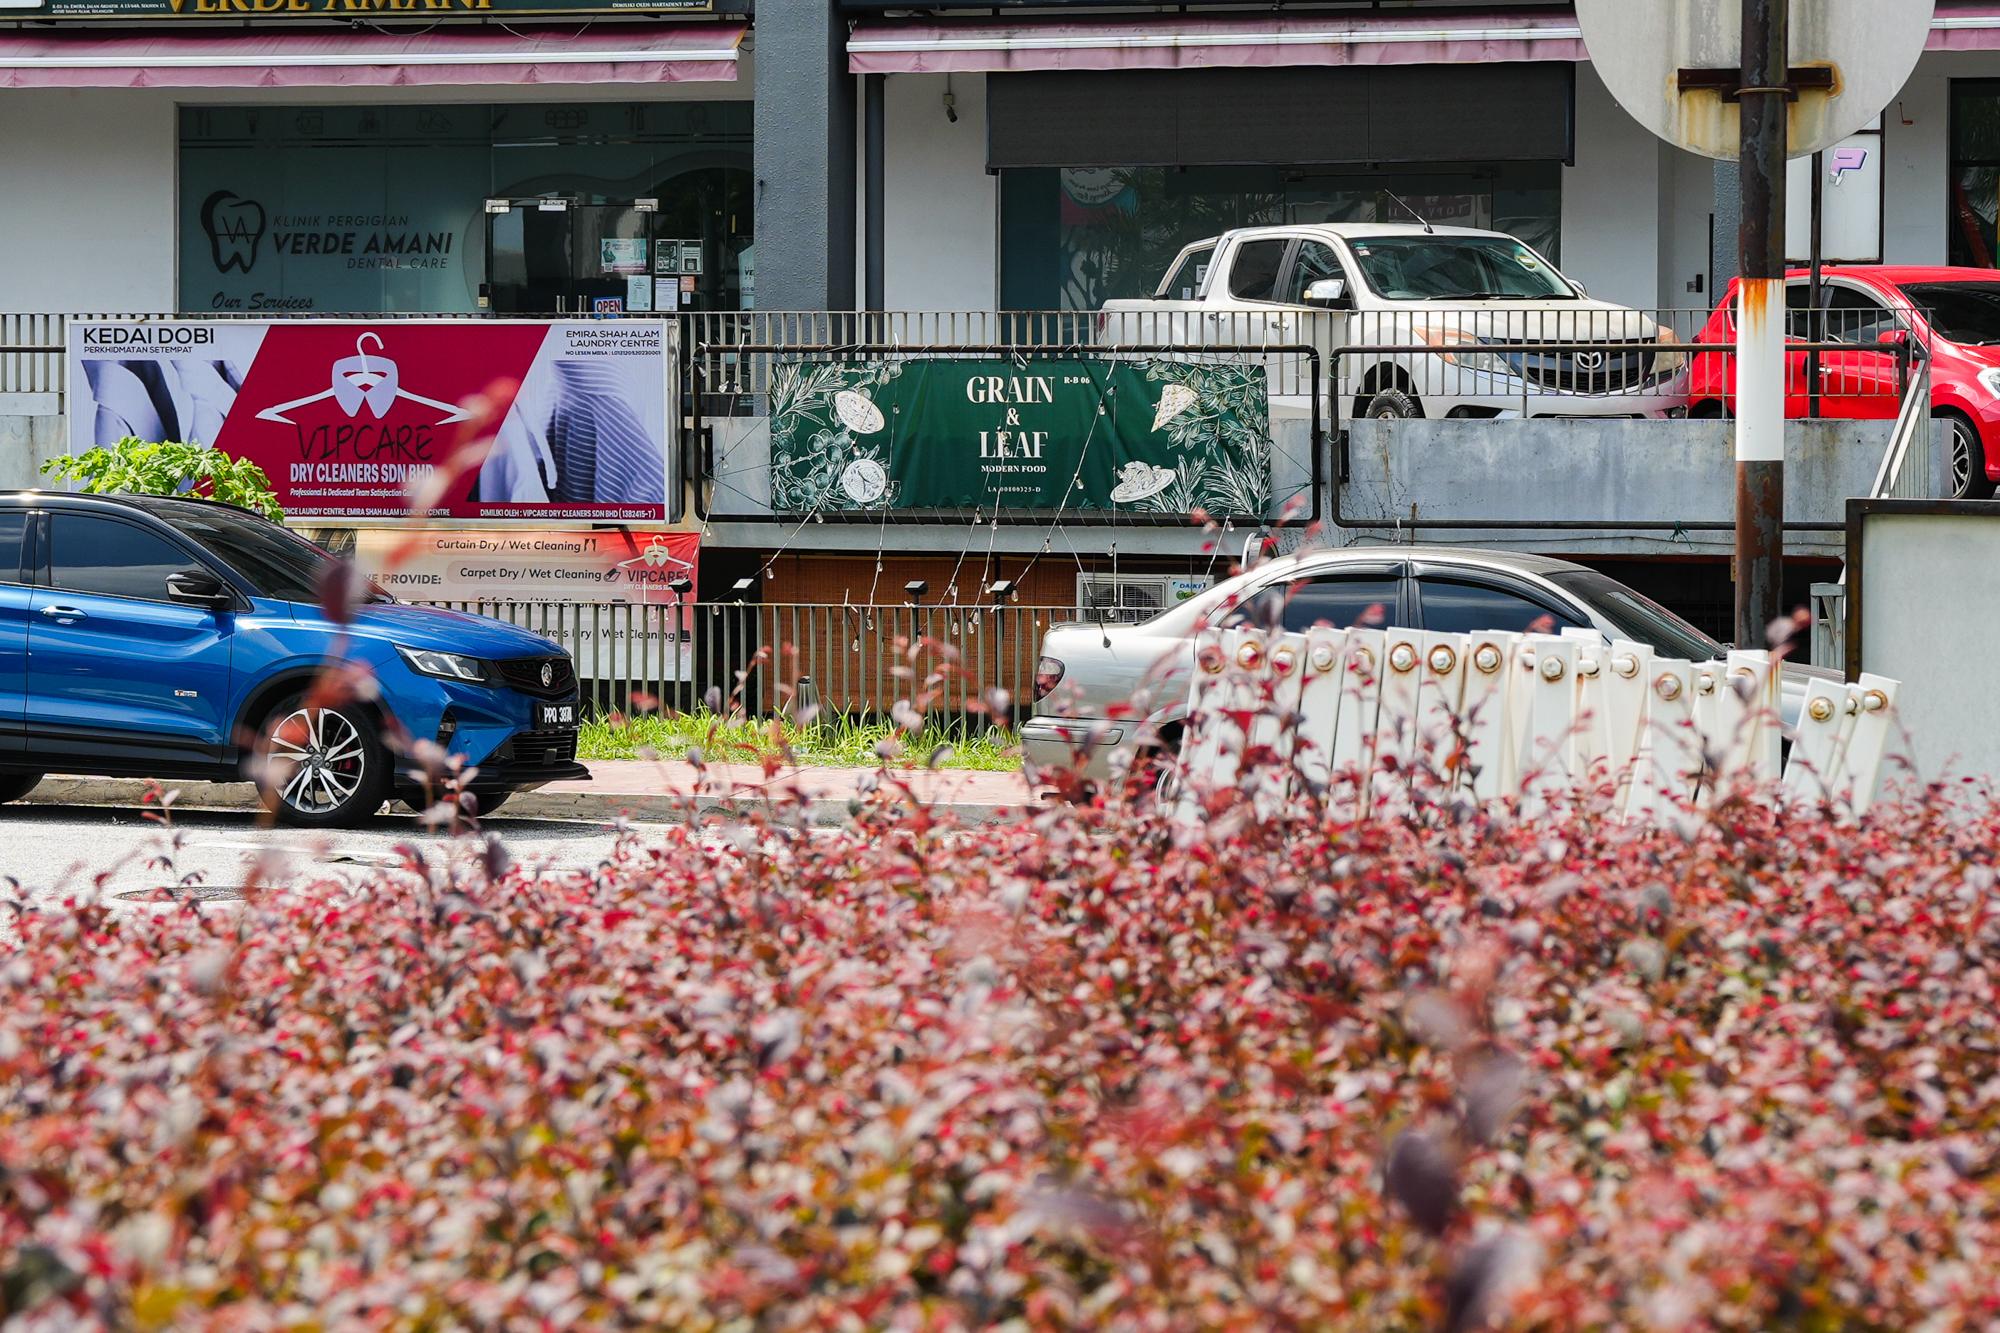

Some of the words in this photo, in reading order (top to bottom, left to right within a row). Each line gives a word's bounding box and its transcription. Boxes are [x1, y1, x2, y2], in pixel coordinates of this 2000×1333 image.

[273, 215, 321, 227] KLINIK
[327, 215, 409, 227] PERGIGIAN
[273, 232, 355, 254] VERDE
[363, 232, 453, 254] AMANI
[347, 257, 401, 269] DENTAL
[409, 257, 448, 269] CARE
[211, 291, 241, 309] Our
[247, 292, 315, 309] Services
[597, 301, 621, 312] OPEN
[84, 328, 152, 344] KEDAI
[158, 328, 214, 344] DOBI
[566, 330, 598, 338] EMIRA
[600, 330, 628, 338] SHAH
[630, 330, 660, 338] ALAM
[570, 340, 618, 348] LAUNDRY
[620, 340, 660, 348] CENTRE
[966, 376, 1056, 403] GRAIN
[1081, 376, 1090, 384] 06
[1006, 407, 1020, 426] &
[297, 423, 434, 462] VIPCARE
[979, 431, 1049, 458] LEAF
[290, 463, 314, 483] DRY
[316, 463, 379, 483] CLEANERS
[381, 464, 405, 483] SDN
[408, 464, 434, 483] BHD
[981, 465, 1019, 473] MODERN
[1021, 465, 1046, 473] FOOD
[290, 488, 322, 498] Professional
[323, 488, 327, 496] &
[328, 488, 355, 497] Dedicated
[356, 489, 370, 497] Team
[370, 488, 401, 499] Satisfaction
[299, 507, 322, 516] LAUNDY
[347, 507, 365, 516] EMIRA
[366, 508, 381, 516] SHAH
[382, 508, 399, 516] ALAM
[428, 508, 450, 516] CENTRE
[523, 509, 548, 517] VIPCARE
[549, 509, 561, 517] DRY
[562, 509, 592, 517] CLEANERS
[592, 509, 604, 518] SDN
[605, 509, 618, 518] BHD
[437, 540, 476, 550] Curtain
[480, 541, 499, 552] Dry
[509, 541, 531, 550] Wet
[534, 540, 581, 552] Cleaning
[382, 574, 442, 585] PROVIDE:
[460, 568, 497, 580] Carpet
[500, 569, 519, 580] Dry
[529, 569, 551, 578] Wet
[554, 568, 602, 581] Cleaning
